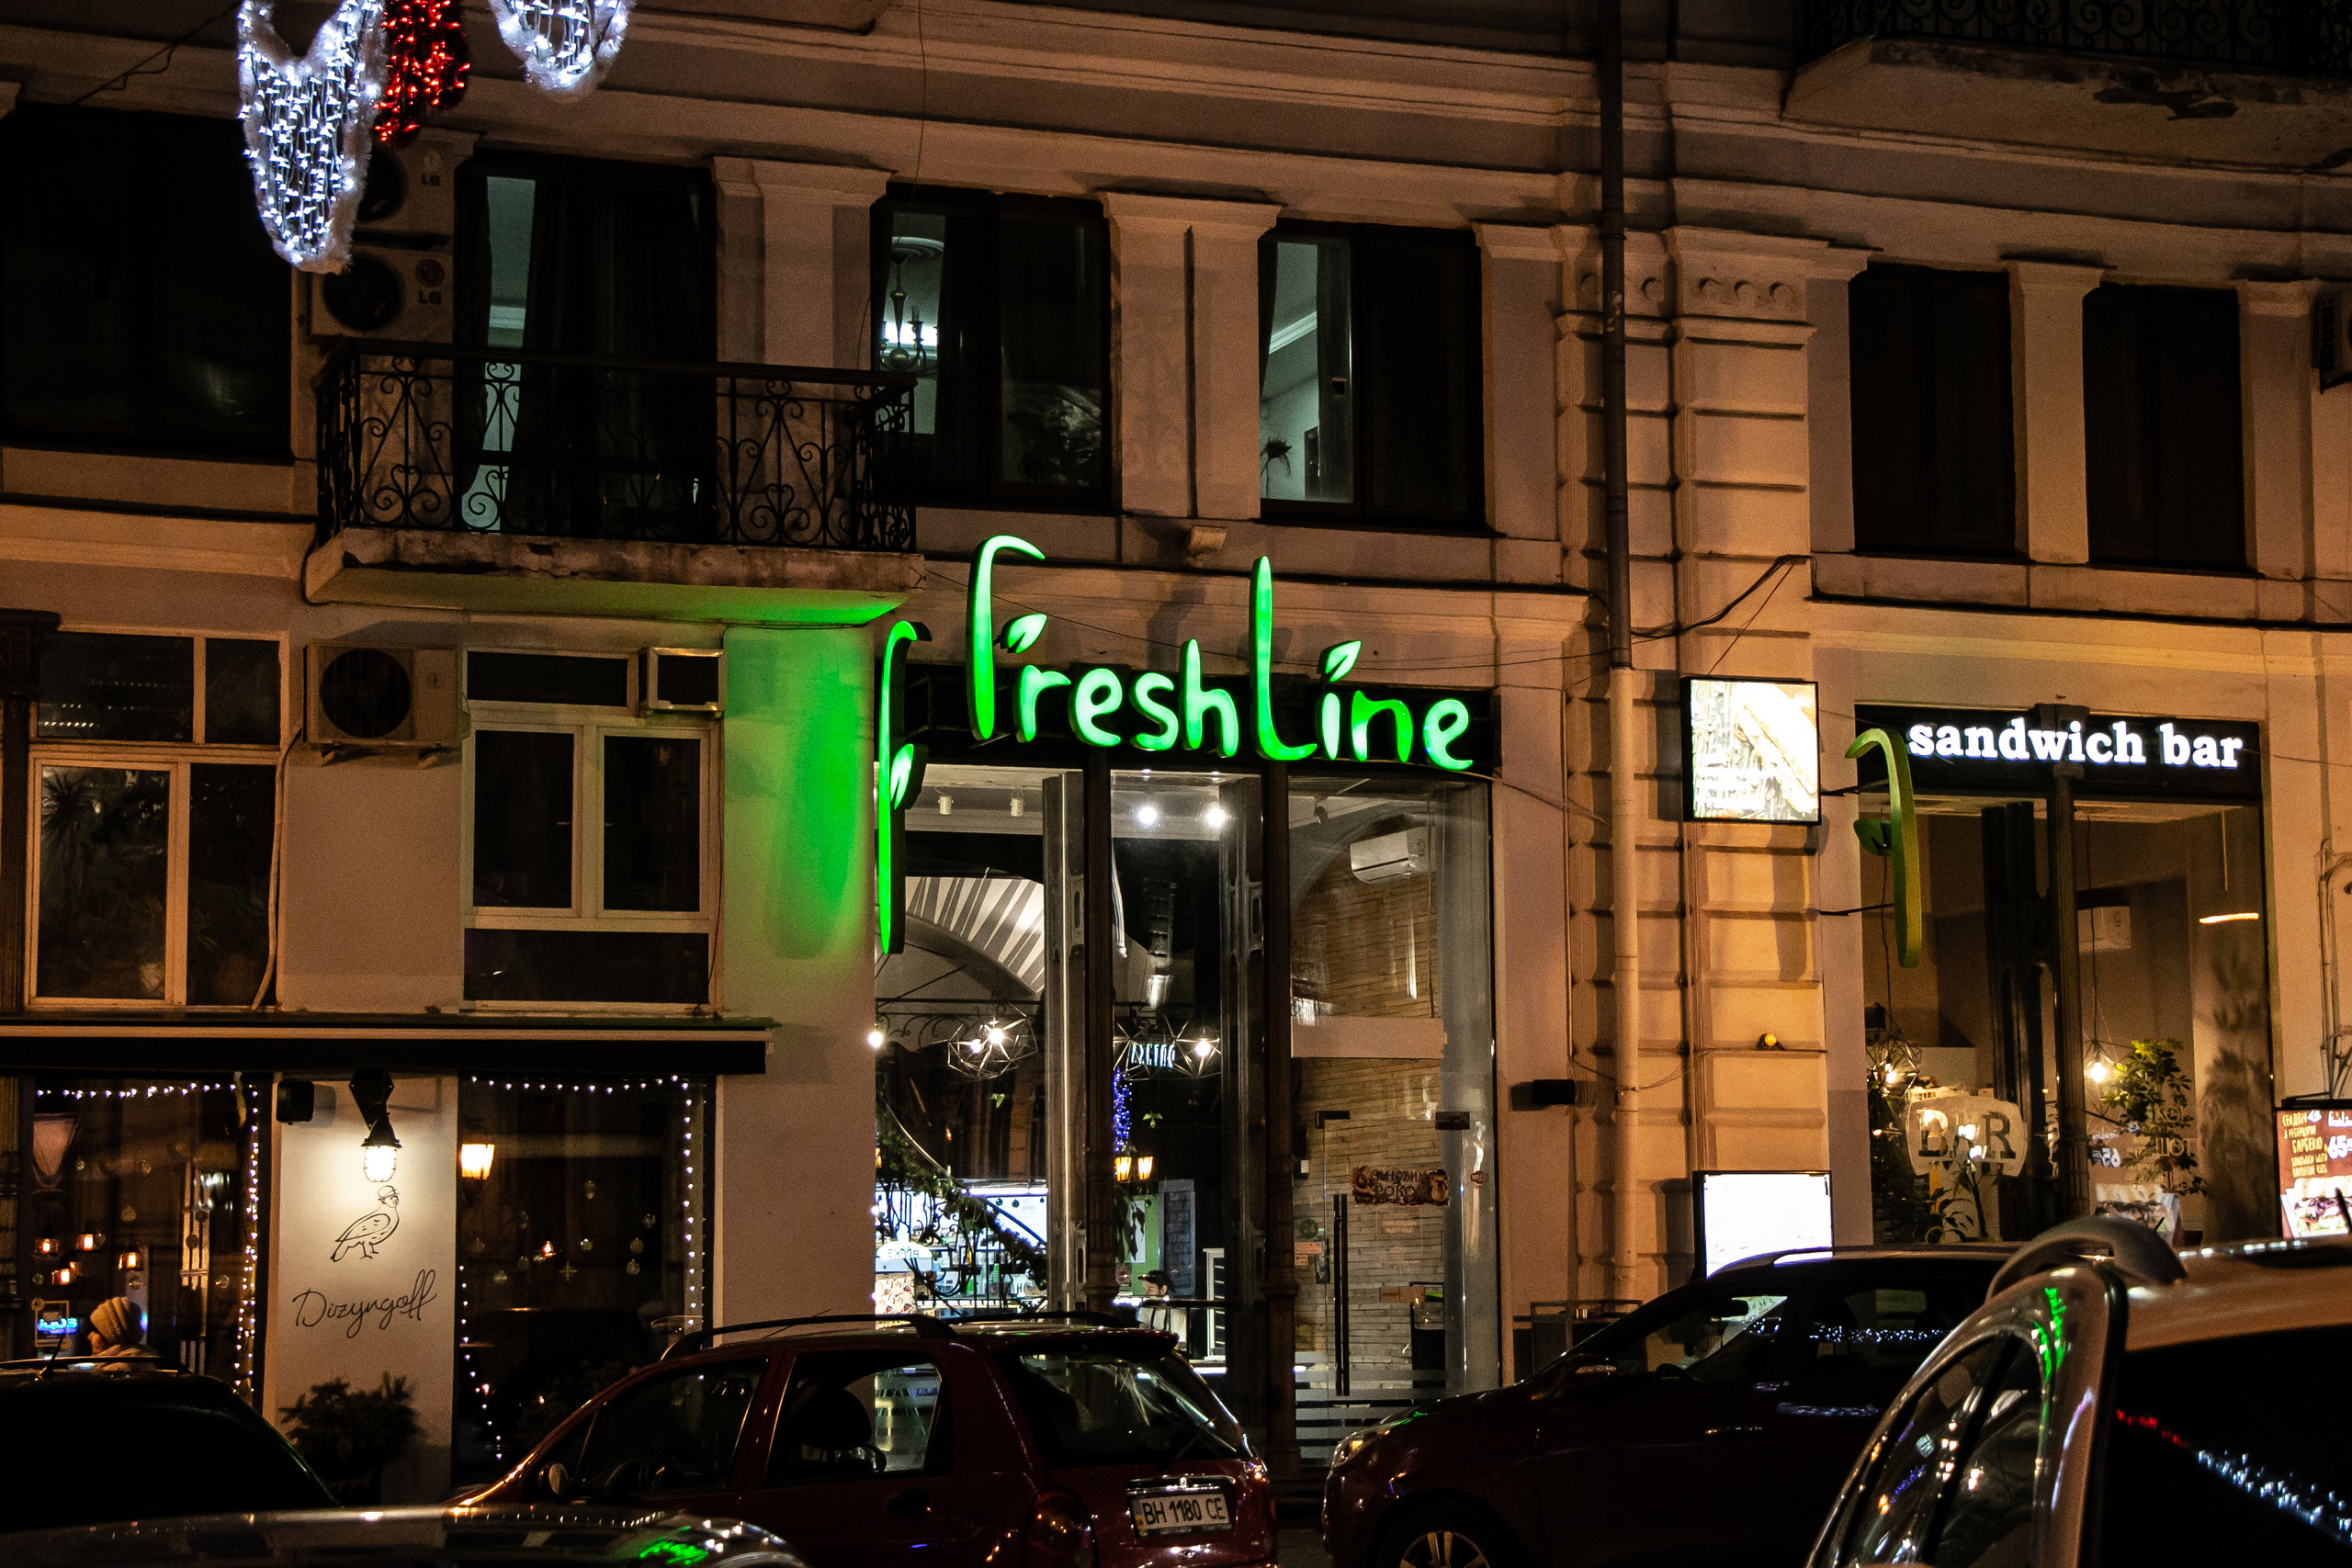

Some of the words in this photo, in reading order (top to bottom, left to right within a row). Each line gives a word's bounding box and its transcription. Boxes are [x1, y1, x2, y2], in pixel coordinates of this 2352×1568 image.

[421, 173, 441, 187] LG
[418, 290, 443, 306] LG
[1908, 717, 2147, 765] sandwich
[2159, 722, 2244, 769] bar
[2327, 1134, 2347, 1158] 65
[291, 1269, 438, 1338] Dizyngoff
[1141, 1501, 1167, 1526] BH
[1169, 1498, 1202, 1524] 1180
[1205, 1497, 1227, 1521] CE
